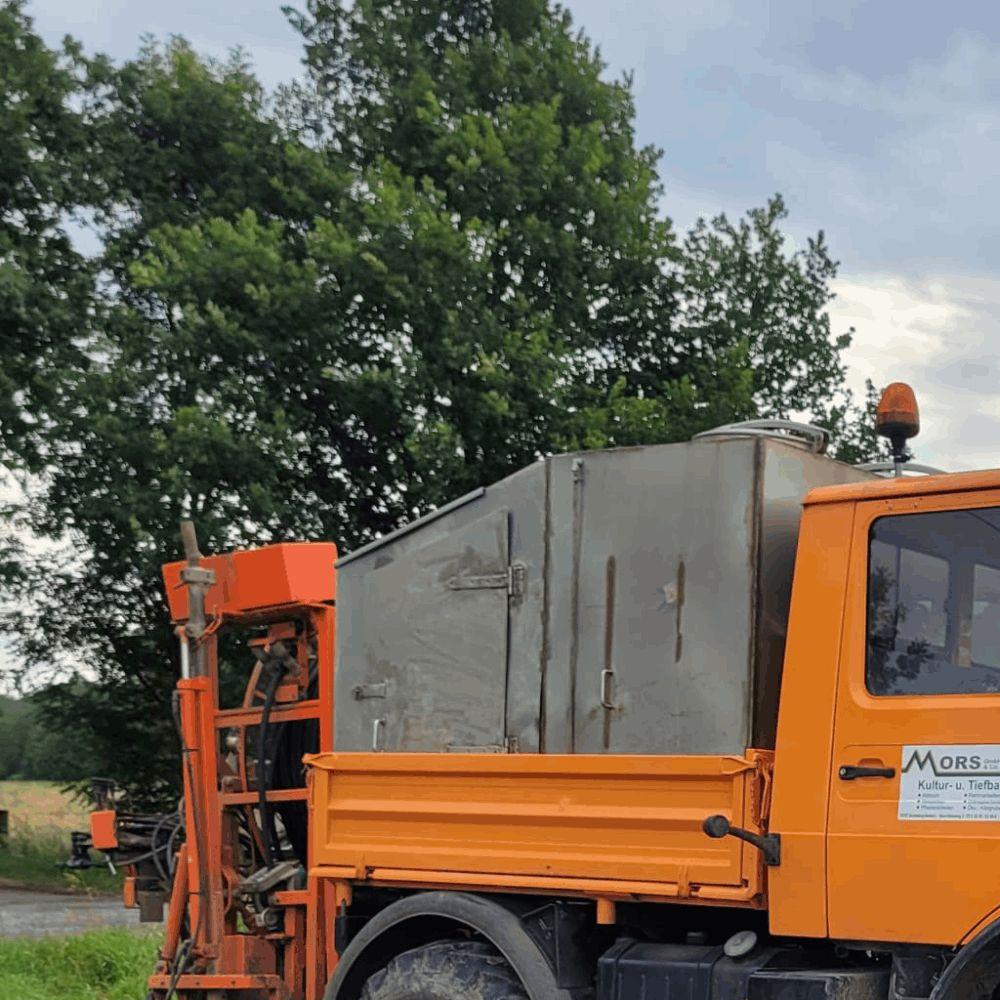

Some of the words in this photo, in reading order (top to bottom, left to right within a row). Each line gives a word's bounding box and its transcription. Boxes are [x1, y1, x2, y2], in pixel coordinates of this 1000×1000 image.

[902, 750, 981, 774] MORS
[918, 779, 953, 791] Kultur-
[956, 781, 965, 791] u.
